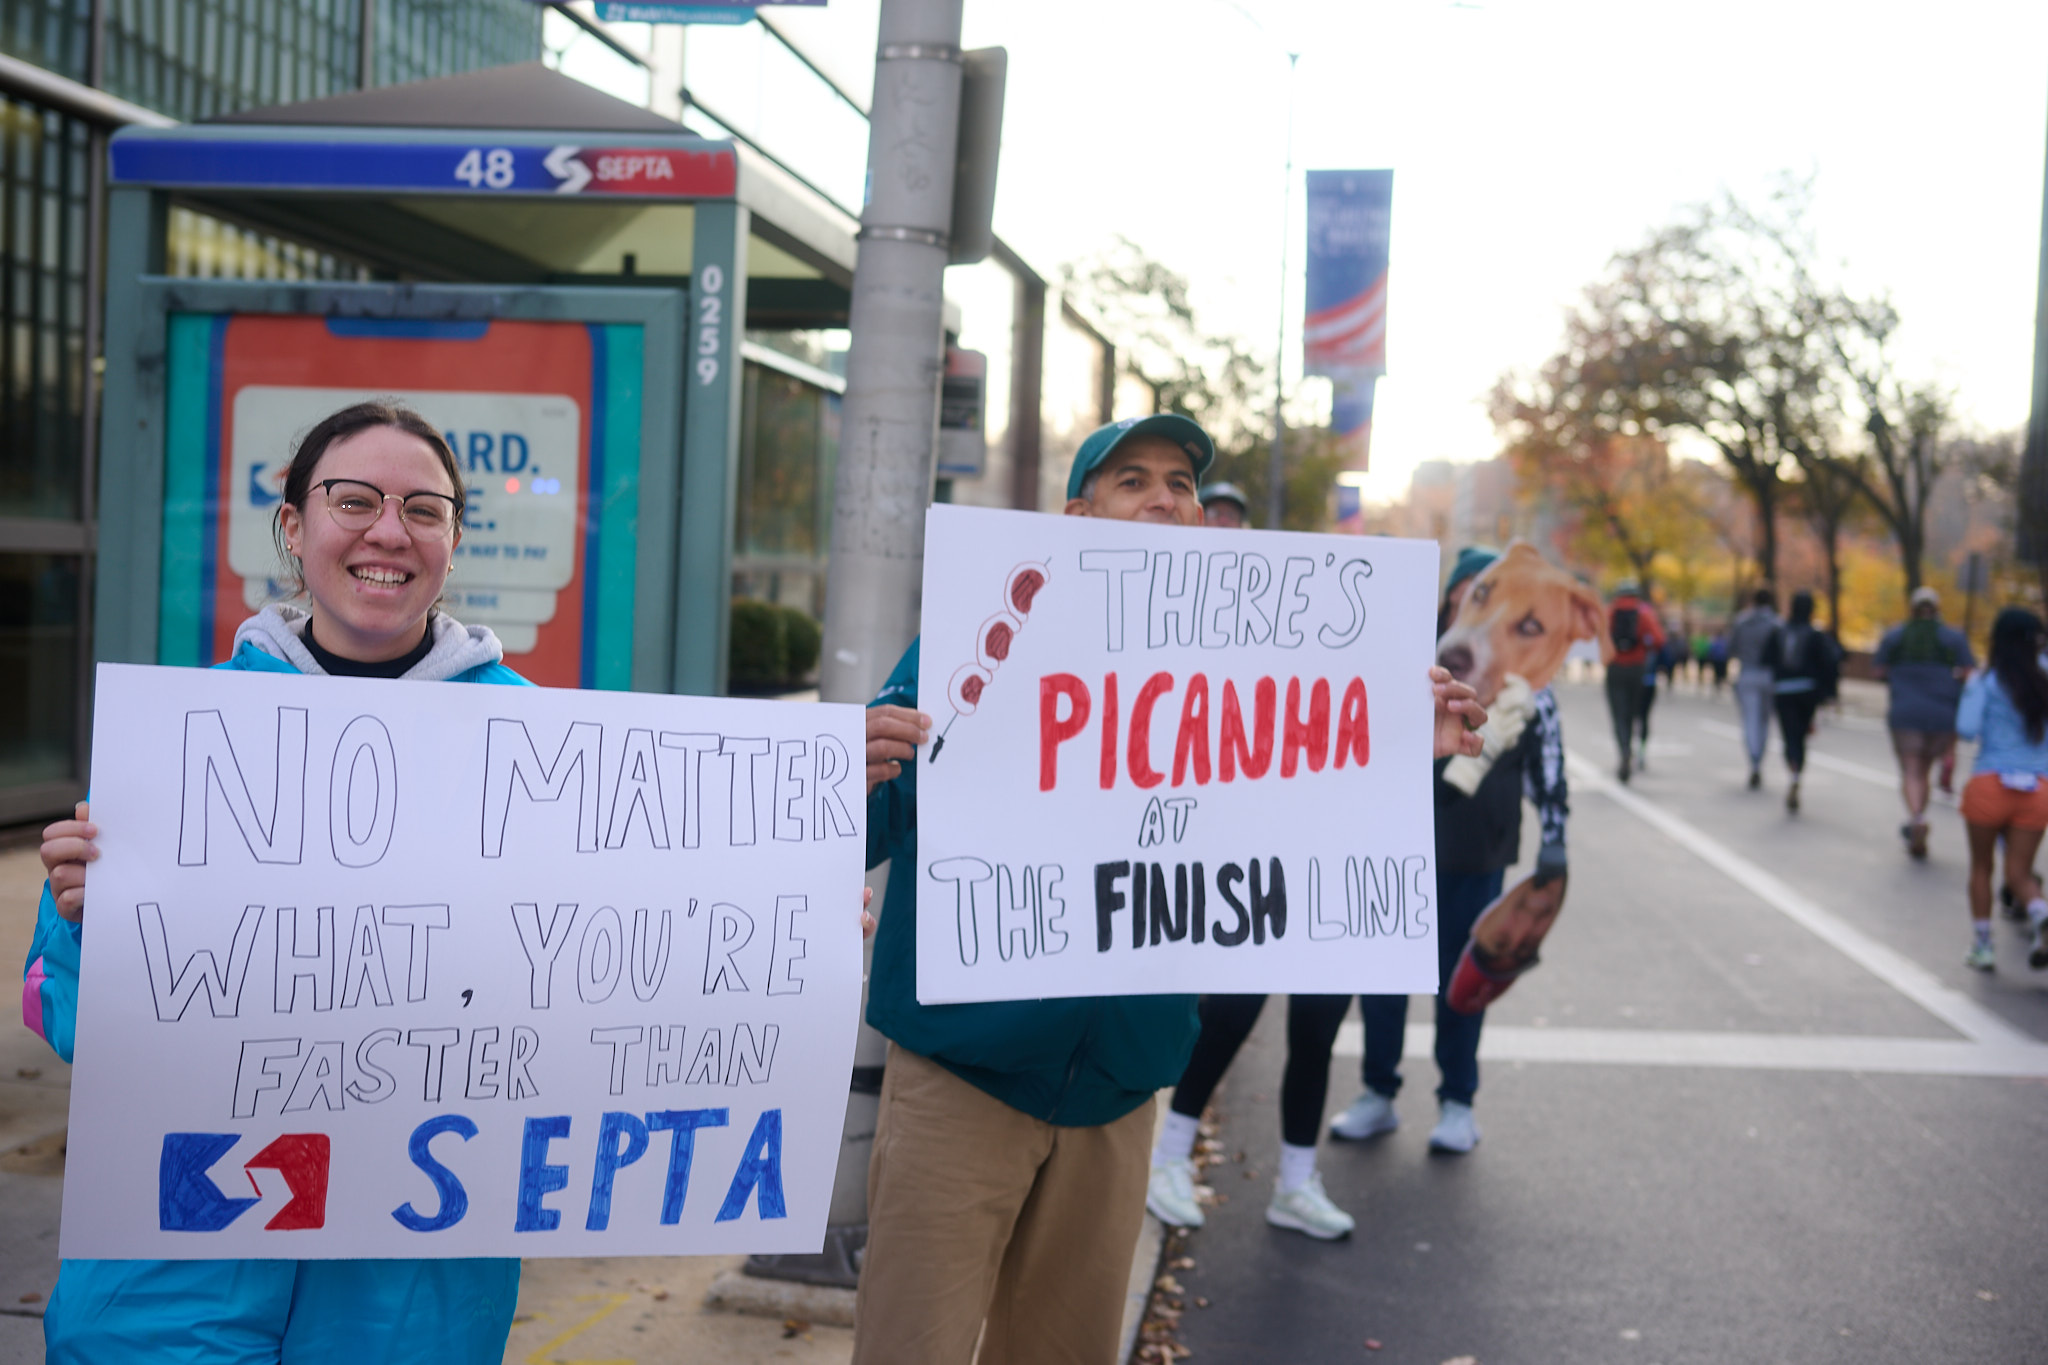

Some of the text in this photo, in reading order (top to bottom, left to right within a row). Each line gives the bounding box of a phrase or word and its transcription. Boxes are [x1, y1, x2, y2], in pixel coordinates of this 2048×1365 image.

[454, 148, 673, 189] 48 SEPTA
[697, 265, 723, 387] 0259
[1079, 549, 1373, 652] THERE'S
[178, 706, 857, 868] NO MATTER
[1038, 671, 1371, 792] PICANHA
[1138, 796, 1197, 847] AT
[137, 894, 808, 1022] WHAT, YOU'RE
[929, 855, 1429, 966] THE FINISH LINE
[231, 1023, 780, 1119] FASTER THAN
[391, 1108, 788, 1233] SEPTA
